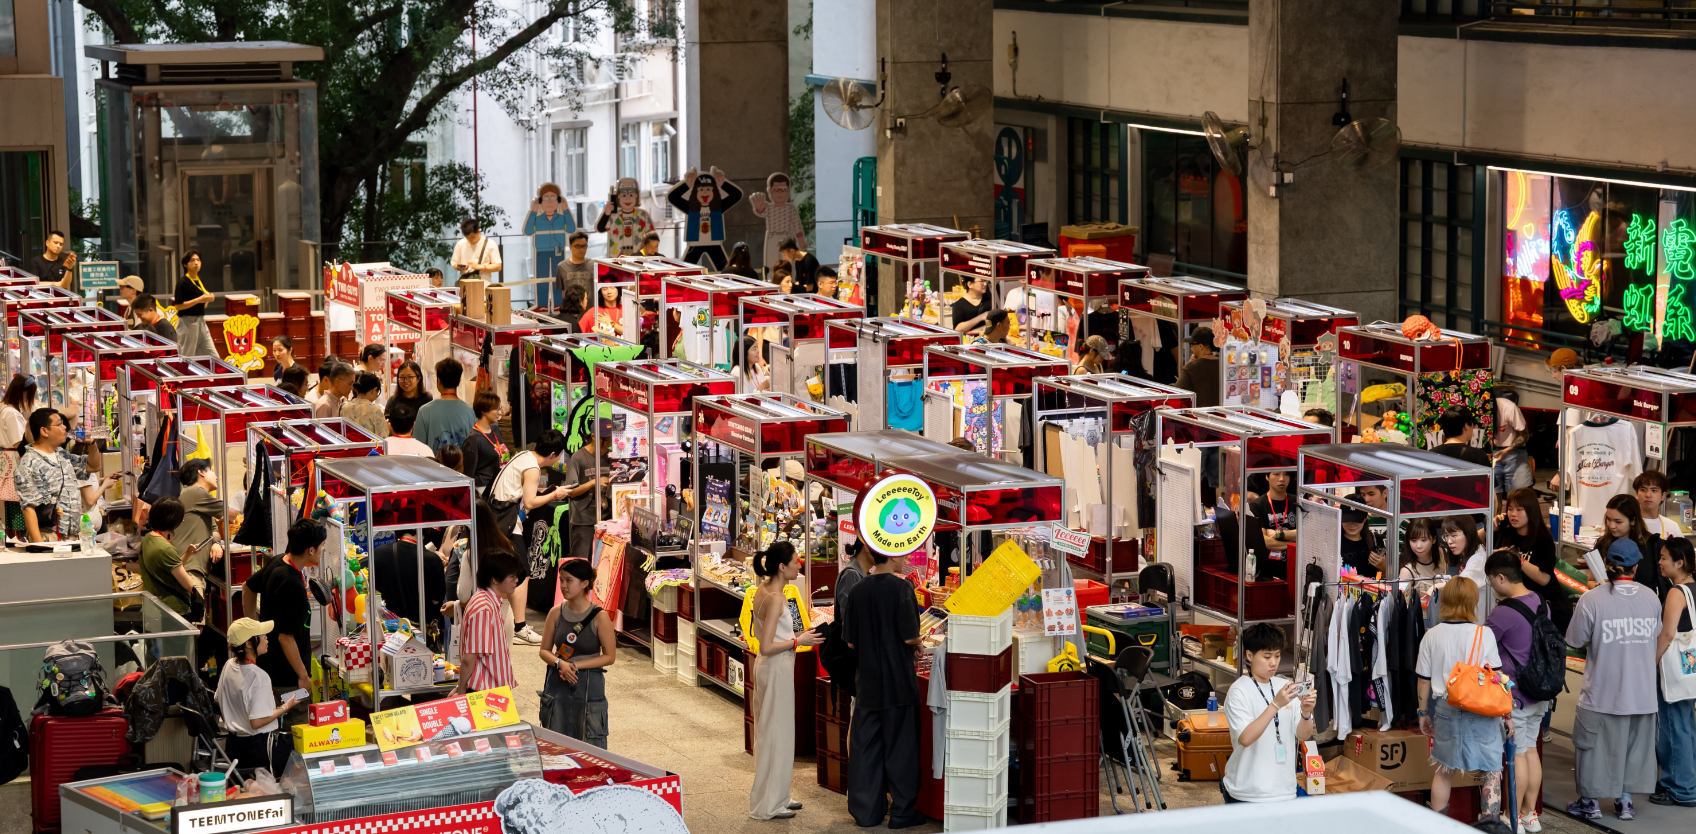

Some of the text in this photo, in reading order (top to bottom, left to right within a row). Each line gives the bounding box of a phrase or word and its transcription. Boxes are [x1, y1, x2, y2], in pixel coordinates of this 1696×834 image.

[338, 282, 347, 294] TWO
[347, 284, 358, 298] GUYS
[371, 334, 383, 342] OF
[1343, 340, 1350, 350] 10
[1569, 385, 1579, 396] 09
[872, 530, 892, 547] Made
[906, 525, 927, 545] Earth
[419, 707, 438, 717] SINGLE
[422, 719, 443, 729] DOUBLE
[308, 738, 340, 748] ALWAYS
[188, 807, 283, 828] TEEMTONEfai
